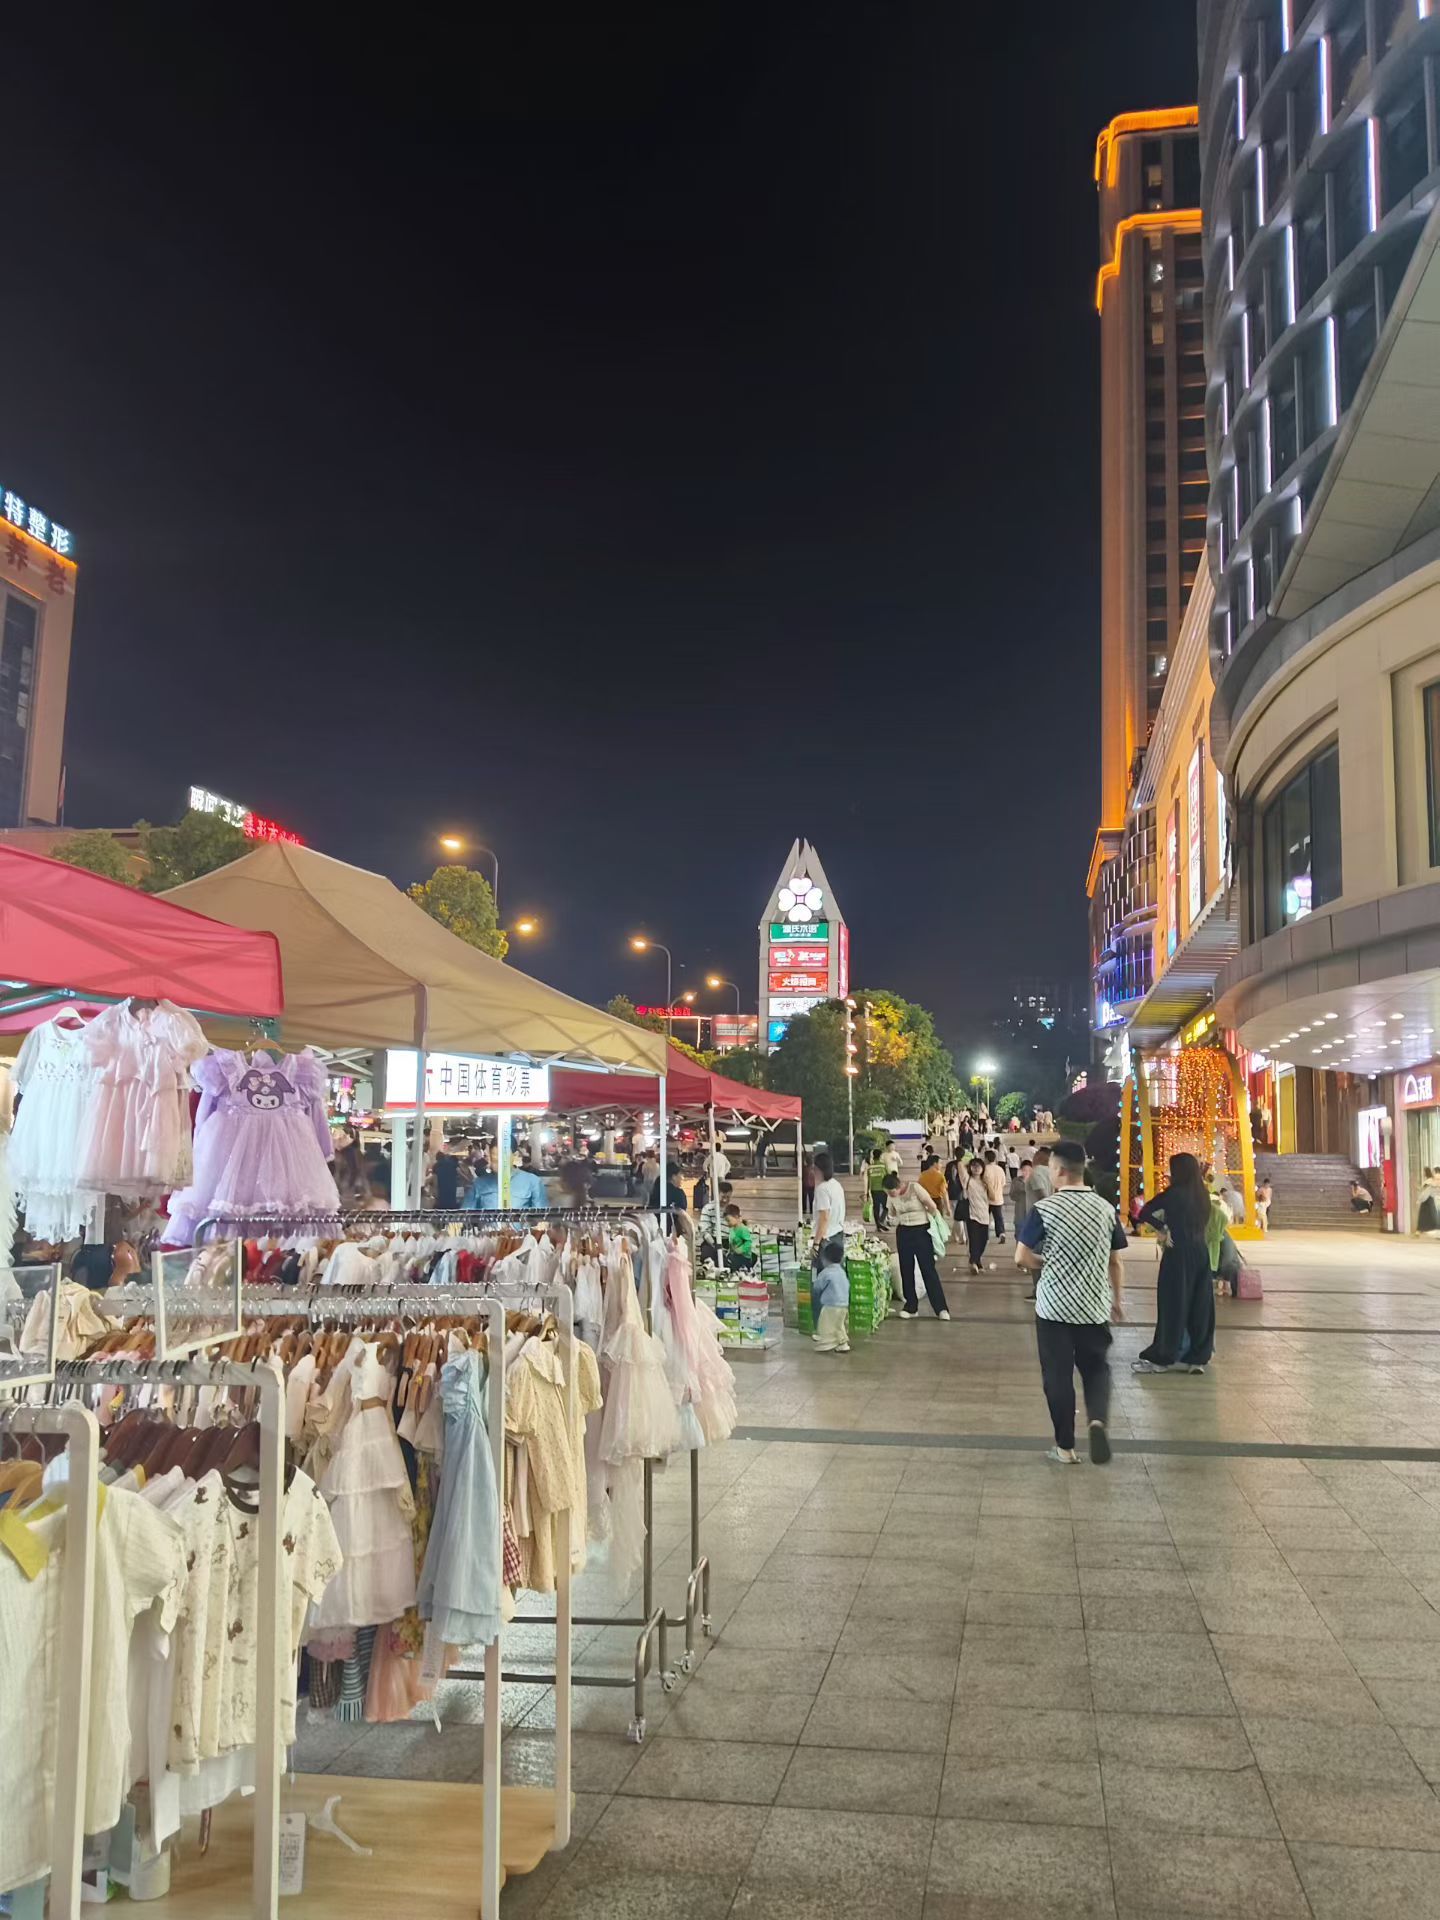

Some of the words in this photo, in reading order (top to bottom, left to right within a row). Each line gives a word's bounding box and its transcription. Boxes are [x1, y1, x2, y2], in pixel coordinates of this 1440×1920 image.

[440, 1060, 531, 1096] 中国体育彩票
